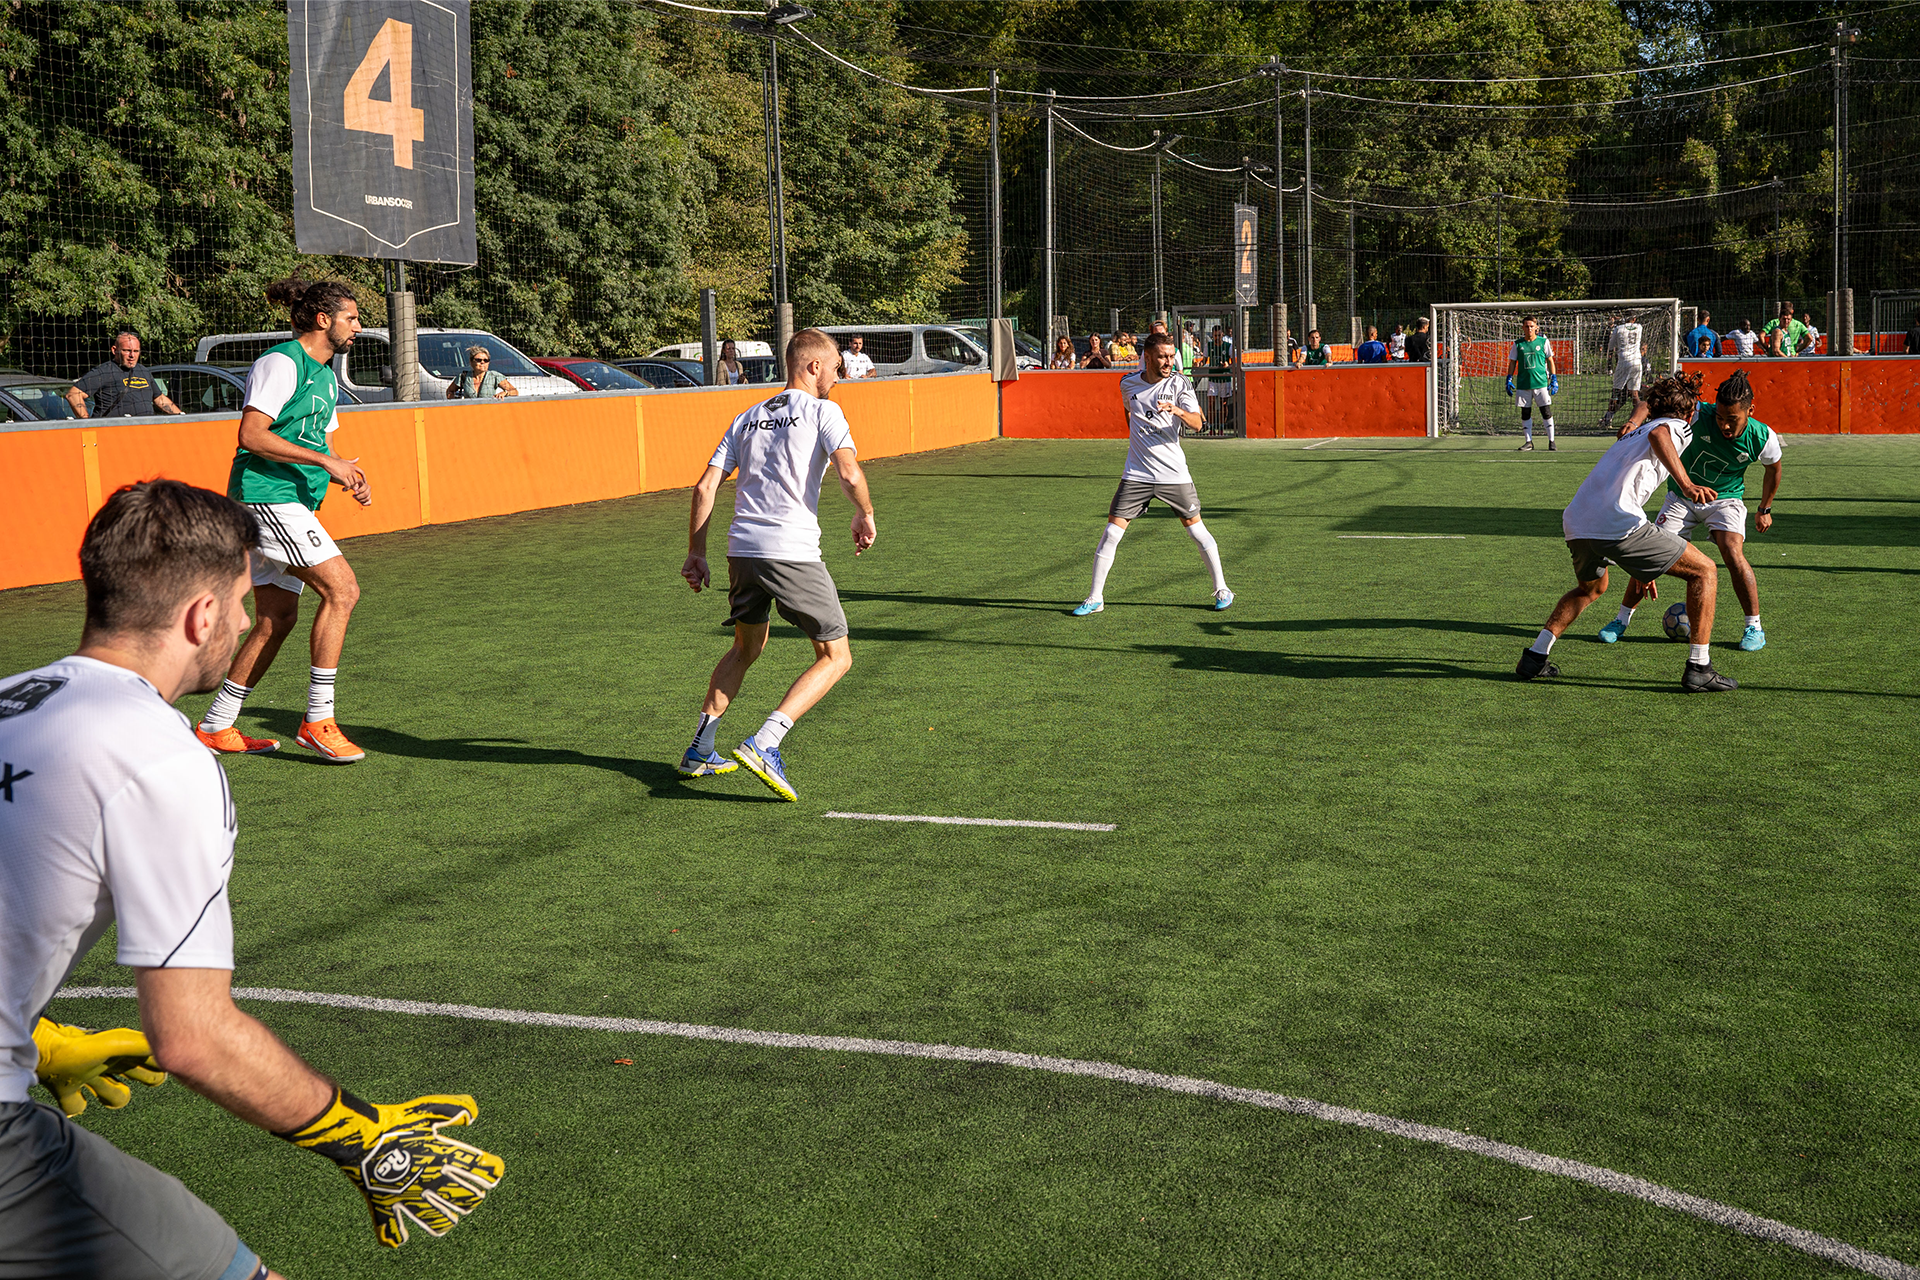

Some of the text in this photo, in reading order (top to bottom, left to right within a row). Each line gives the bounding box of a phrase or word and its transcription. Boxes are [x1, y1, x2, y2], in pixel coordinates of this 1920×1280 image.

[344, 18, 424, 169] 4
[1241, 220, 1252, 273] 2
[306, 529, 322, 548] 6
